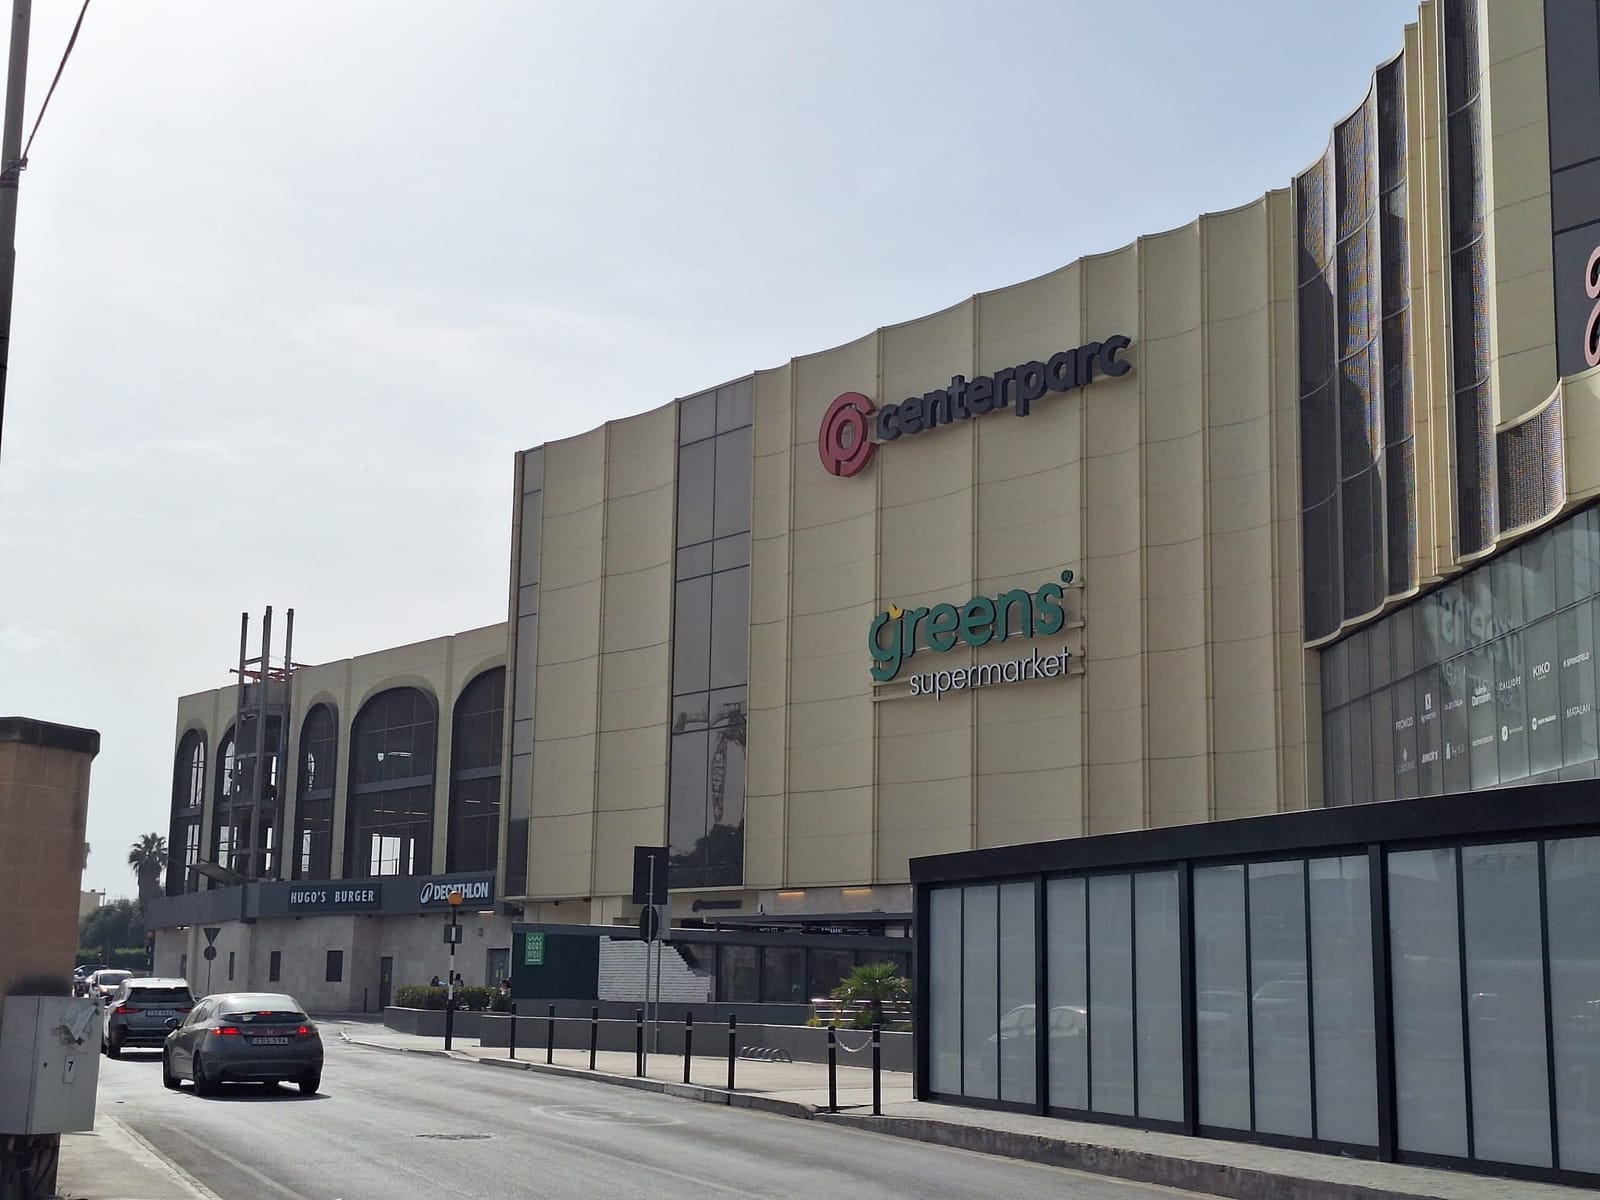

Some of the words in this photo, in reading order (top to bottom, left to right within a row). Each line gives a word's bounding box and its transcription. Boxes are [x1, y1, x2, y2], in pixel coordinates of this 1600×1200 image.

[876, 334, 1131, 441] centerparc
[909, 647, 1071, 700] supermarket
[1532, 661, 1551, 678] KIKO
[1566, 703, 1591, 718] MATALAN
[290, 890, 327, 904] HUGO'S
[334, 890, 375, 903] BURGER
[67, 1060, 75, 1072] 7
